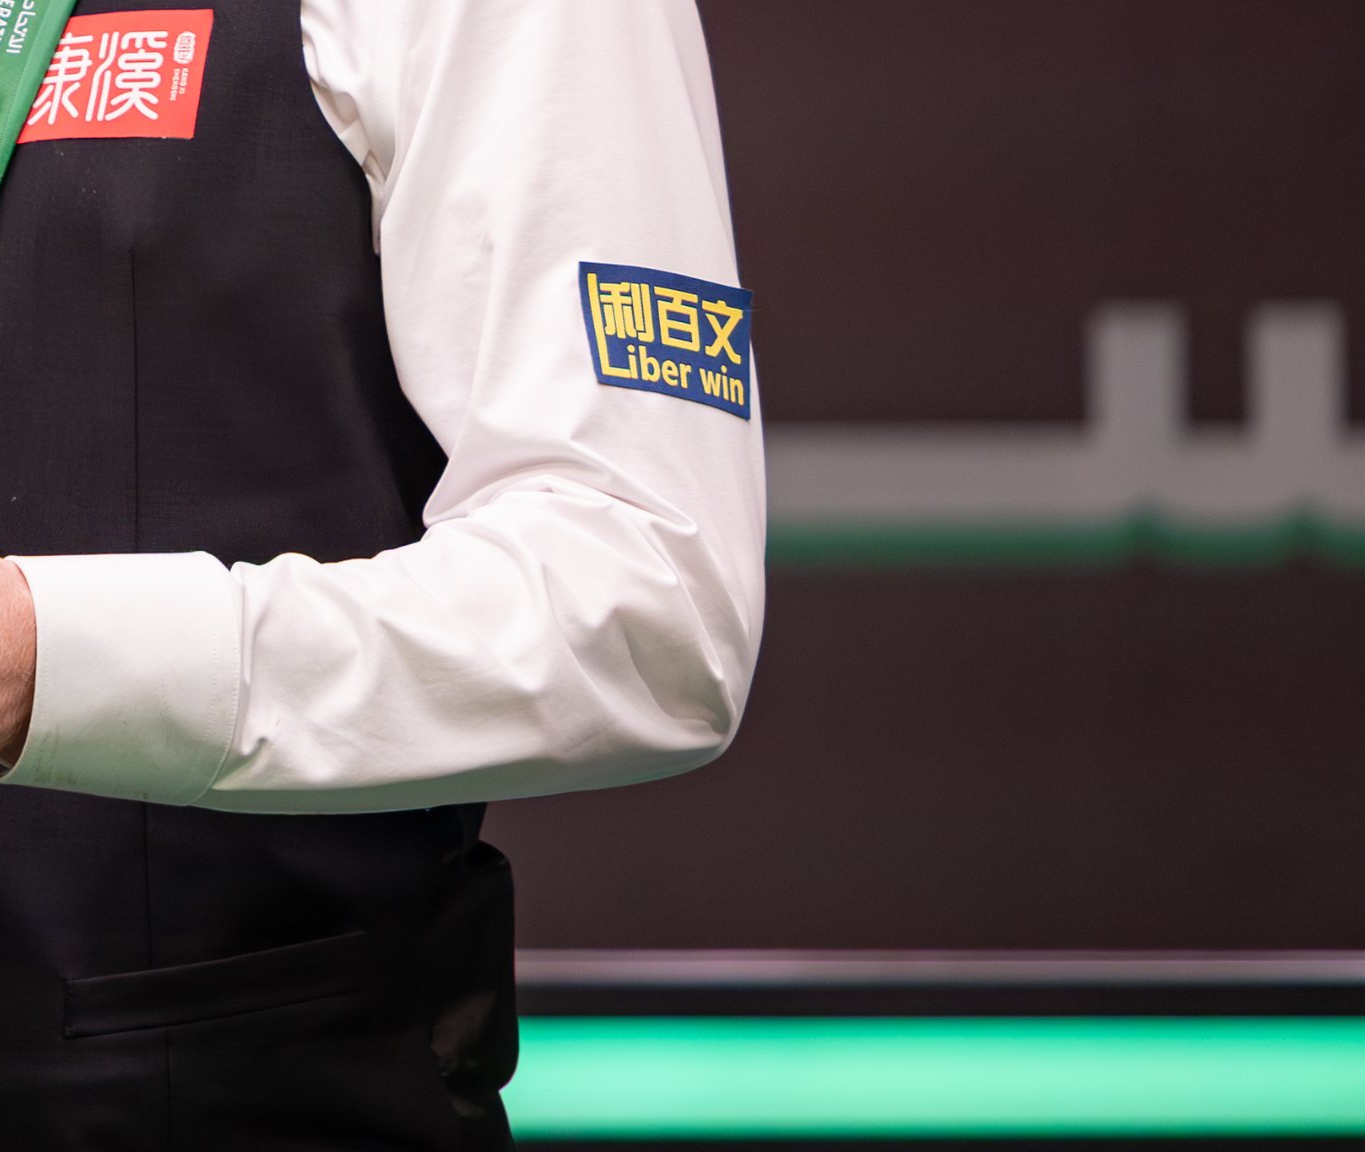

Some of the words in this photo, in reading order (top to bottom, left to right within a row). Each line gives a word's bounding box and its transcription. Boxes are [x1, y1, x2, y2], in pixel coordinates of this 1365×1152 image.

[587, 273, 691, 389] Liber
[699, 365, 744, 405] win
[599, 282, 743, 365] 利百文
